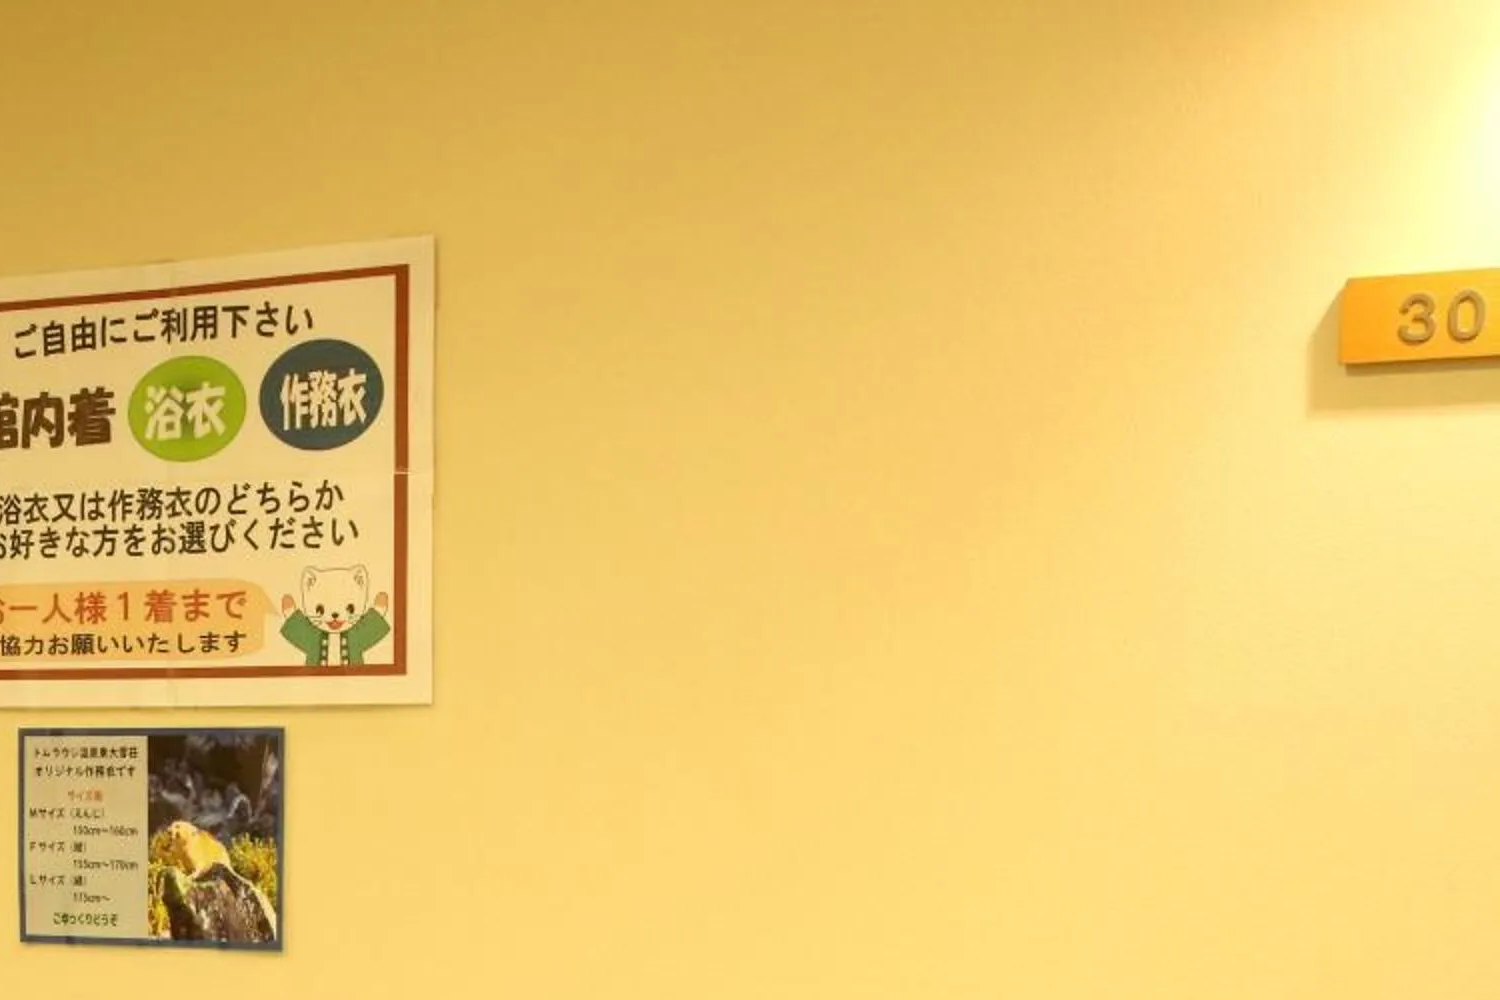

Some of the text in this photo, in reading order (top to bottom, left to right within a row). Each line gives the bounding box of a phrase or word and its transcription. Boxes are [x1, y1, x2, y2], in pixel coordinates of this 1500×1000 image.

[14, 301, 314, 359] ご自由にご利用下さい
[1397, 289, 1486, 346] 30
[143, 380, 226, 442] 浴衣
[280, 367, 368, 432] 作務衣
